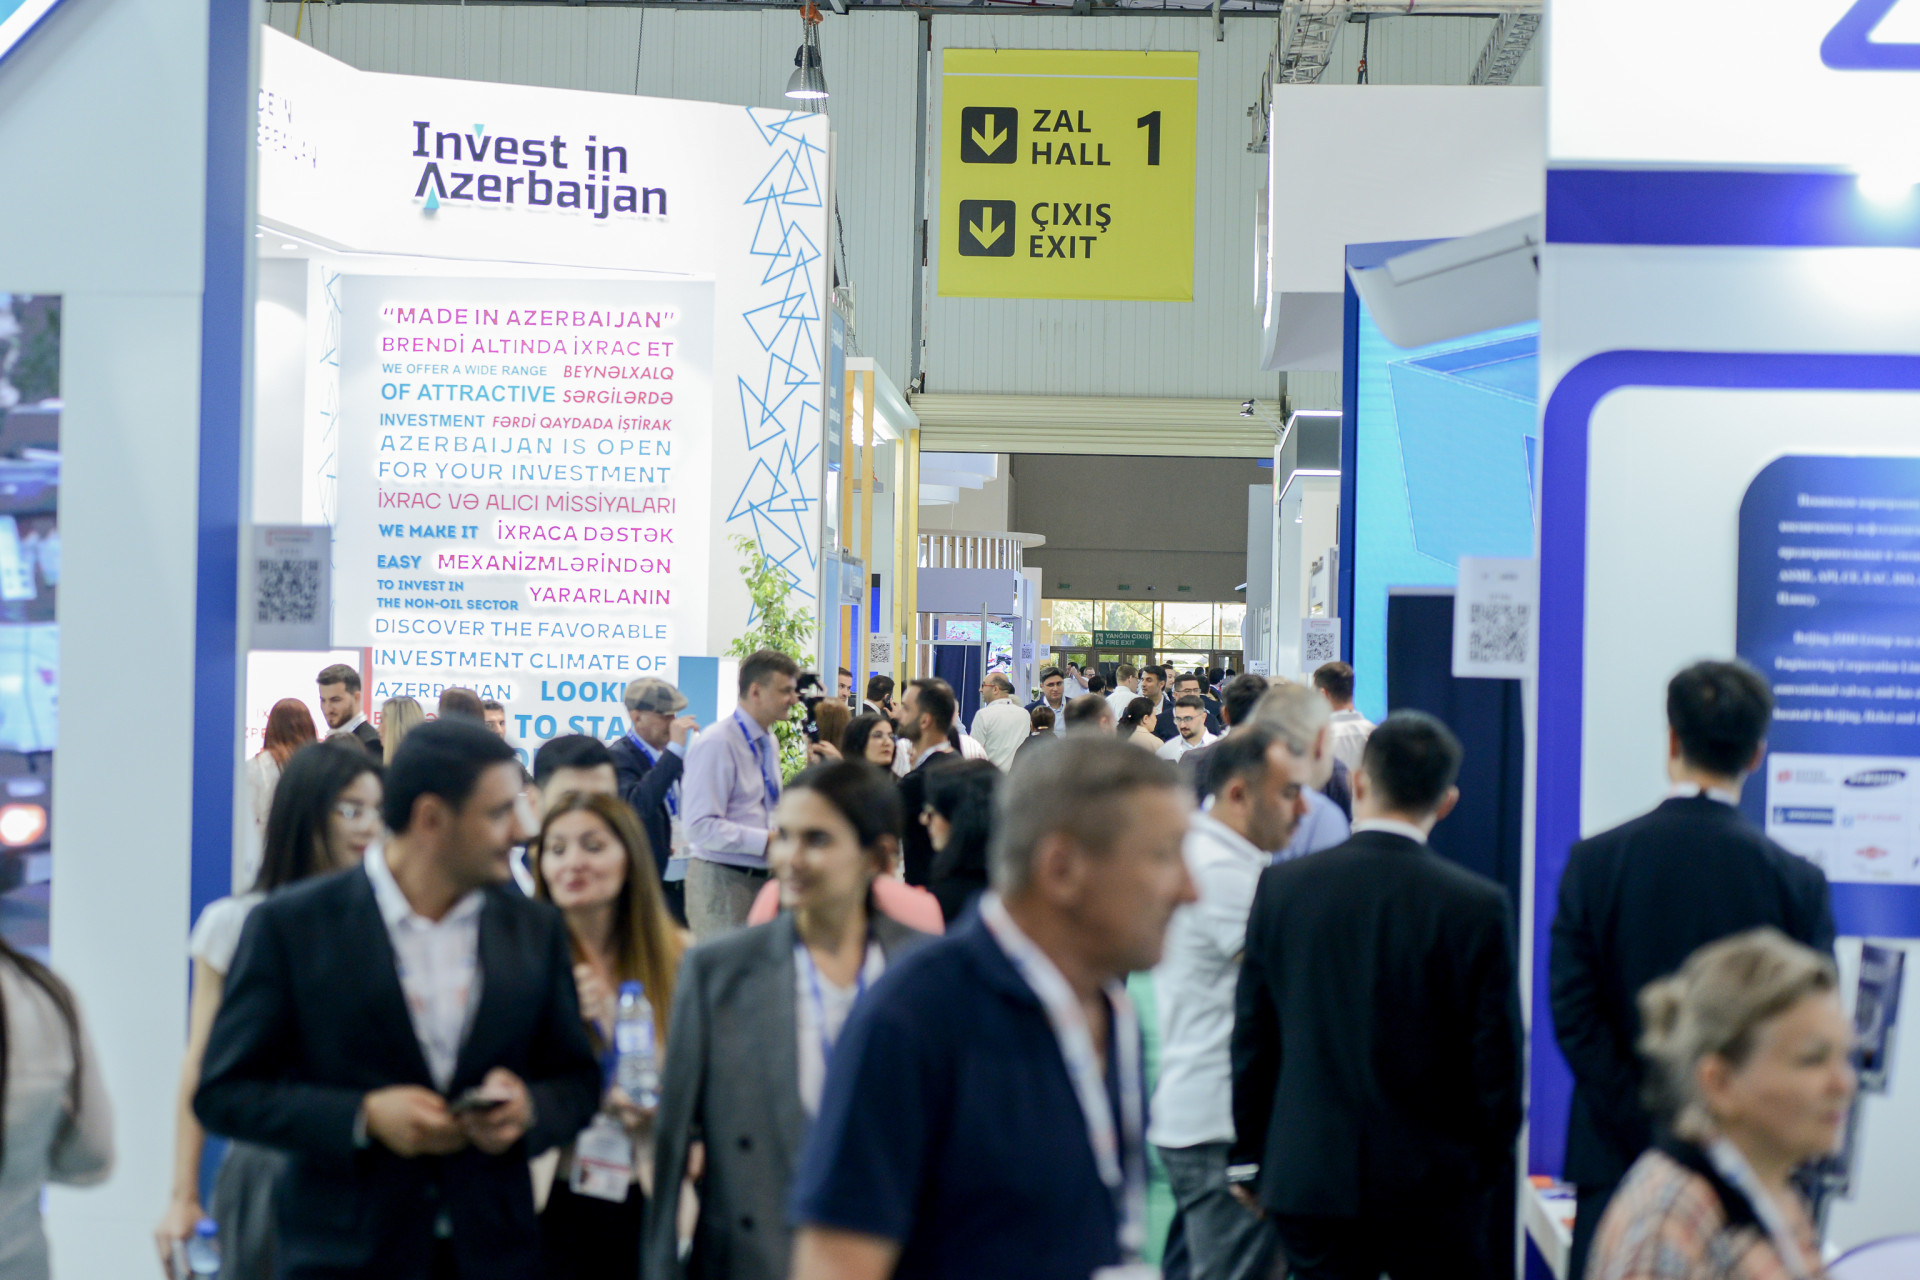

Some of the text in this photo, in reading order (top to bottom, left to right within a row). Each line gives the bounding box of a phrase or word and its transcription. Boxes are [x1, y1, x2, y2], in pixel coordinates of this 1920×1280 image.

[1032, 109, 1092, 133] ZAL
[412, 120, 628, 174] Invest in
[1136, 110, 1161, 166] 1
[1031, 142, 1112, 166] HALL
[414, 161, 668, 219] Azerbaijan
[1031, 201, 1112, 233] ÇIXIŞ
[1029, 235, 1098, 259] EXIT
[475, 309, 499, 325] IN
[382, 333, 674, 358] BRENDİ ALTINDA İXRAC ET
[382, 363, 548, 377] WE OFFER A WIDE RANGE
[563, 365, 675, 381] BEYNƏLXALQ
[381, 383, 556, 403] OF ATTRACTIVE
[562, 387, 674, 406] SƏRGİLƏRDƏ
[380, 413, 486, 428] INVESTMENT
[492, 413, 672, 433] FƏRDİ QAYDADA İŞTİRAK
[380, 435, 671, 456] AZERBAIJAN IS OPEN
[378, 461, 671, 484] FOR YOUR INVESTMENT
[378, 488, 676, 514] İXRAC VƏ ALICI MİSSİYALARI
[378, 523, 479, 539] WE MAKE IT
[498, 520, 674, 544] İXRACA DƏSTƏK
[377, 554, 422, 569] EASY
[438, 551, 671, 574] MEXANİZMLƏRİNDƏN
[377, 579, 464, 592] TO INVEST IN
[529, 586, 671, 605] YARARLANIN
[376, 597, 519, 611] THE NON-OIL SECTOR
[375, 618, 667, 640] DISCOVER THE FAVORABLE
[374, 649, 667, 672] INVESTMENT CLIMATE OF
[375, 682, 511, 700] AZERBAN
[514, 714, 557, 740] TO
